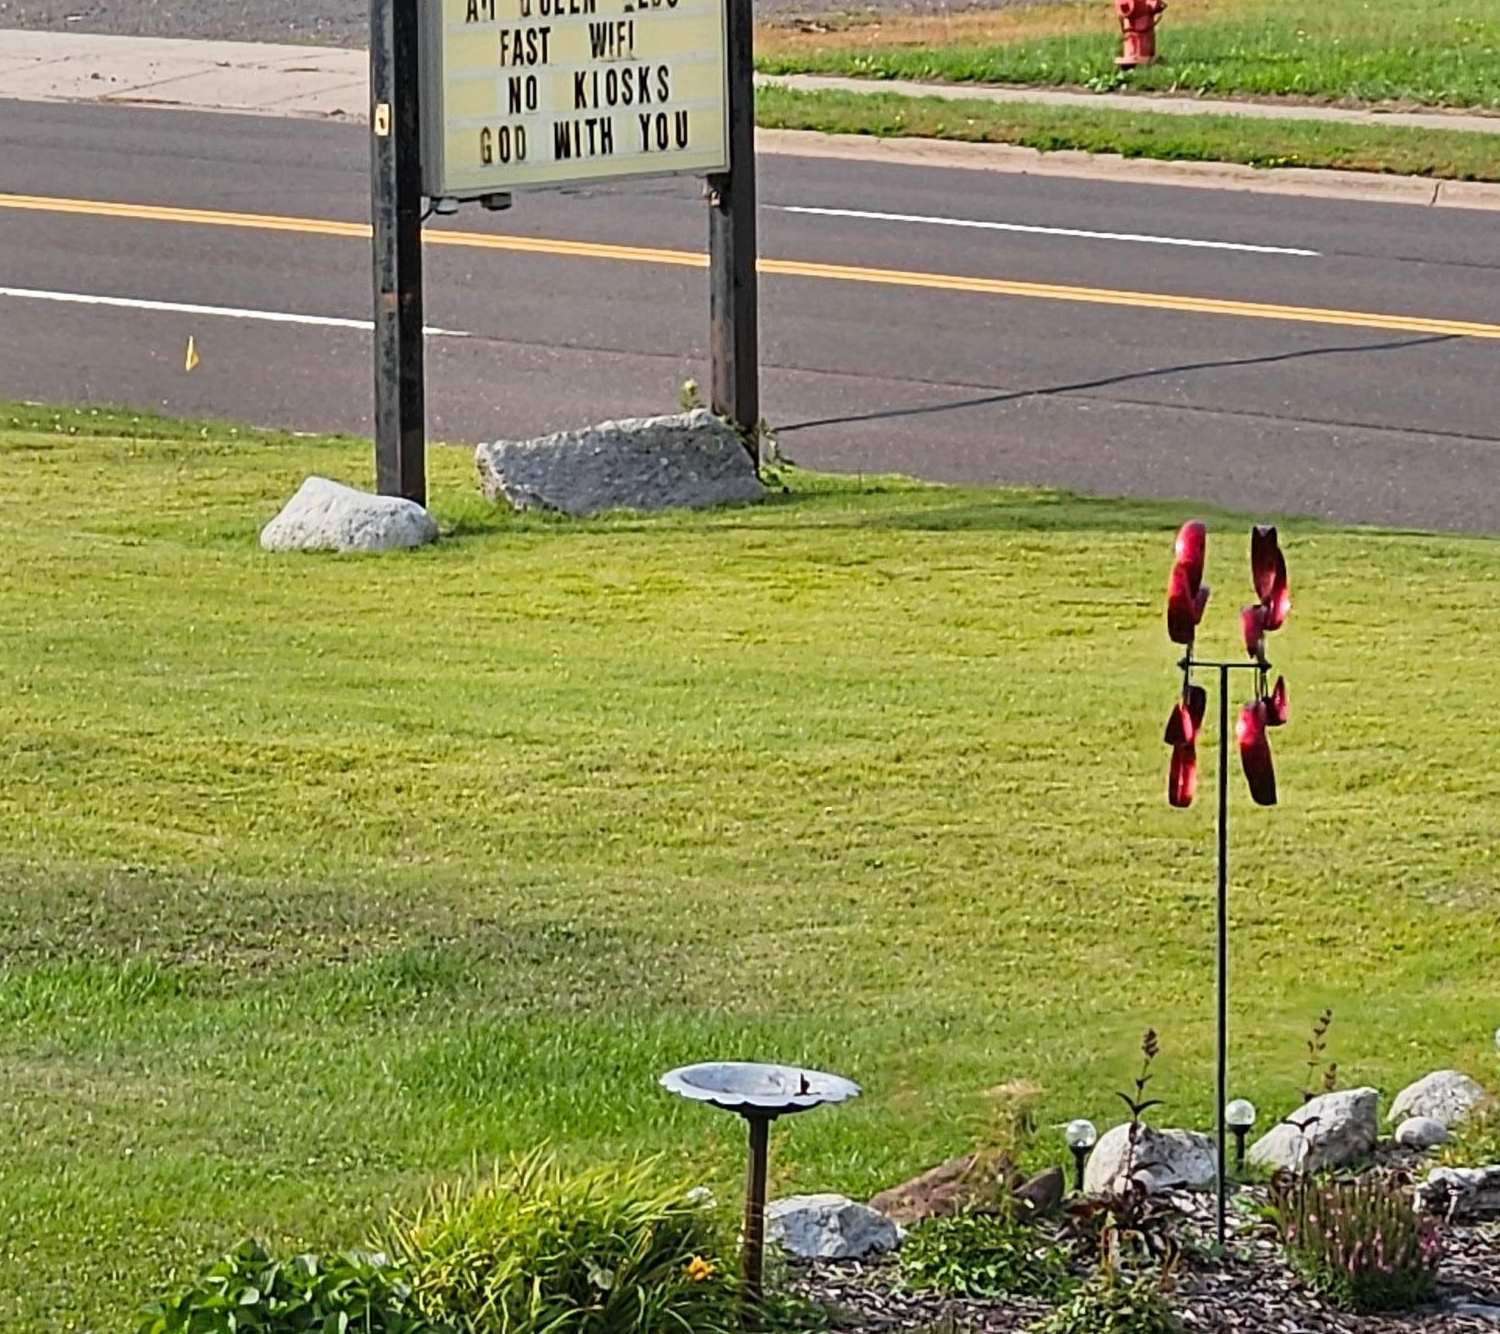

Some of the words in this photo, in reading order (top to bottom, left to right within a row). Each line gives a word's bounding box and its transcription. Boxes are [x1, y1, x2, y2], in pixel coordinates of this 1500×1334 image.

[499, 25, 551, 68] FAST
[588, 19, 635, 60] WIFI
[508, 74, 538, 116] NO
[574, 64, 670, 109] KIOSKS
[479, 123, 527, 165] GOD
[553, 115, 614, 161] WITH
[638, 109, 688, 152] YOU
